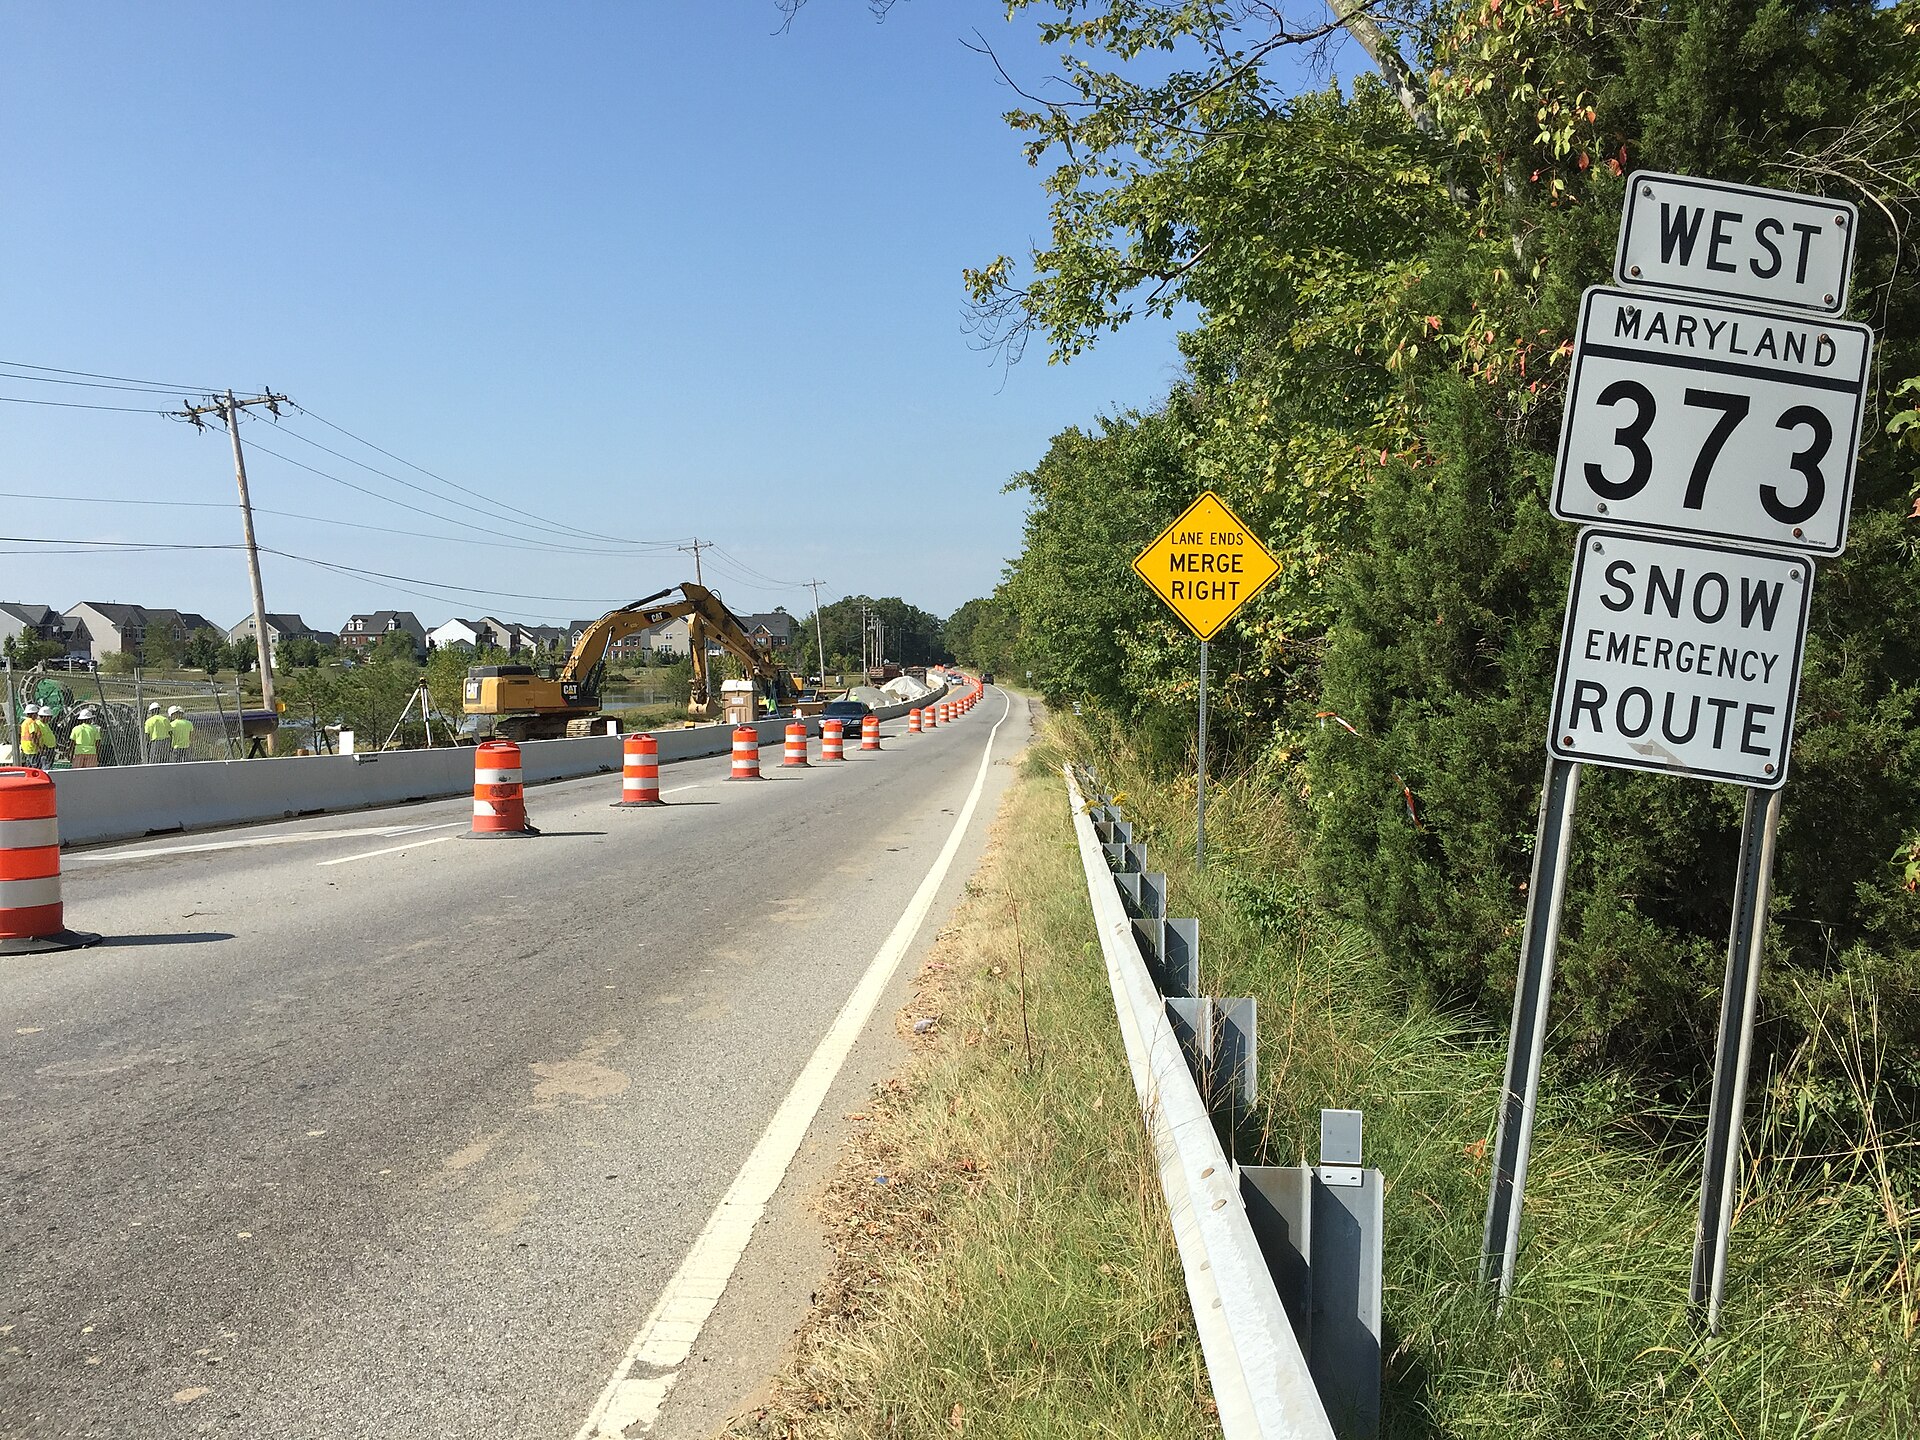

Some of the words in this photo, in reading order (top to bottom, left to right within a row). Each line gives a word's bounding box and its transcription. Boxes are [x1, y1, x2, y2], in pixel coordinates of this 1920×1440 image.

[1660, 202, 1824, 285] WEST
[1614, 305, 1838, 368] MARYLAND
[1583, 379, 1833, 525] 373
[1170, 553, 1244, 573] MERGE
[1171, 531, 1204, 545] LANE
[1210, 531, 1244, 546] ENDS
[651, 612, 664, 623] CAT
[1171, 580, 1241, 601] RIGHT
[1599, 559, 1785, 632] SNOW
[1584, 628, 1780, 684] EMERGENCY
[563, 684, 578, 695] CAT
[1568, 679, 1776, 757] ROUTE
